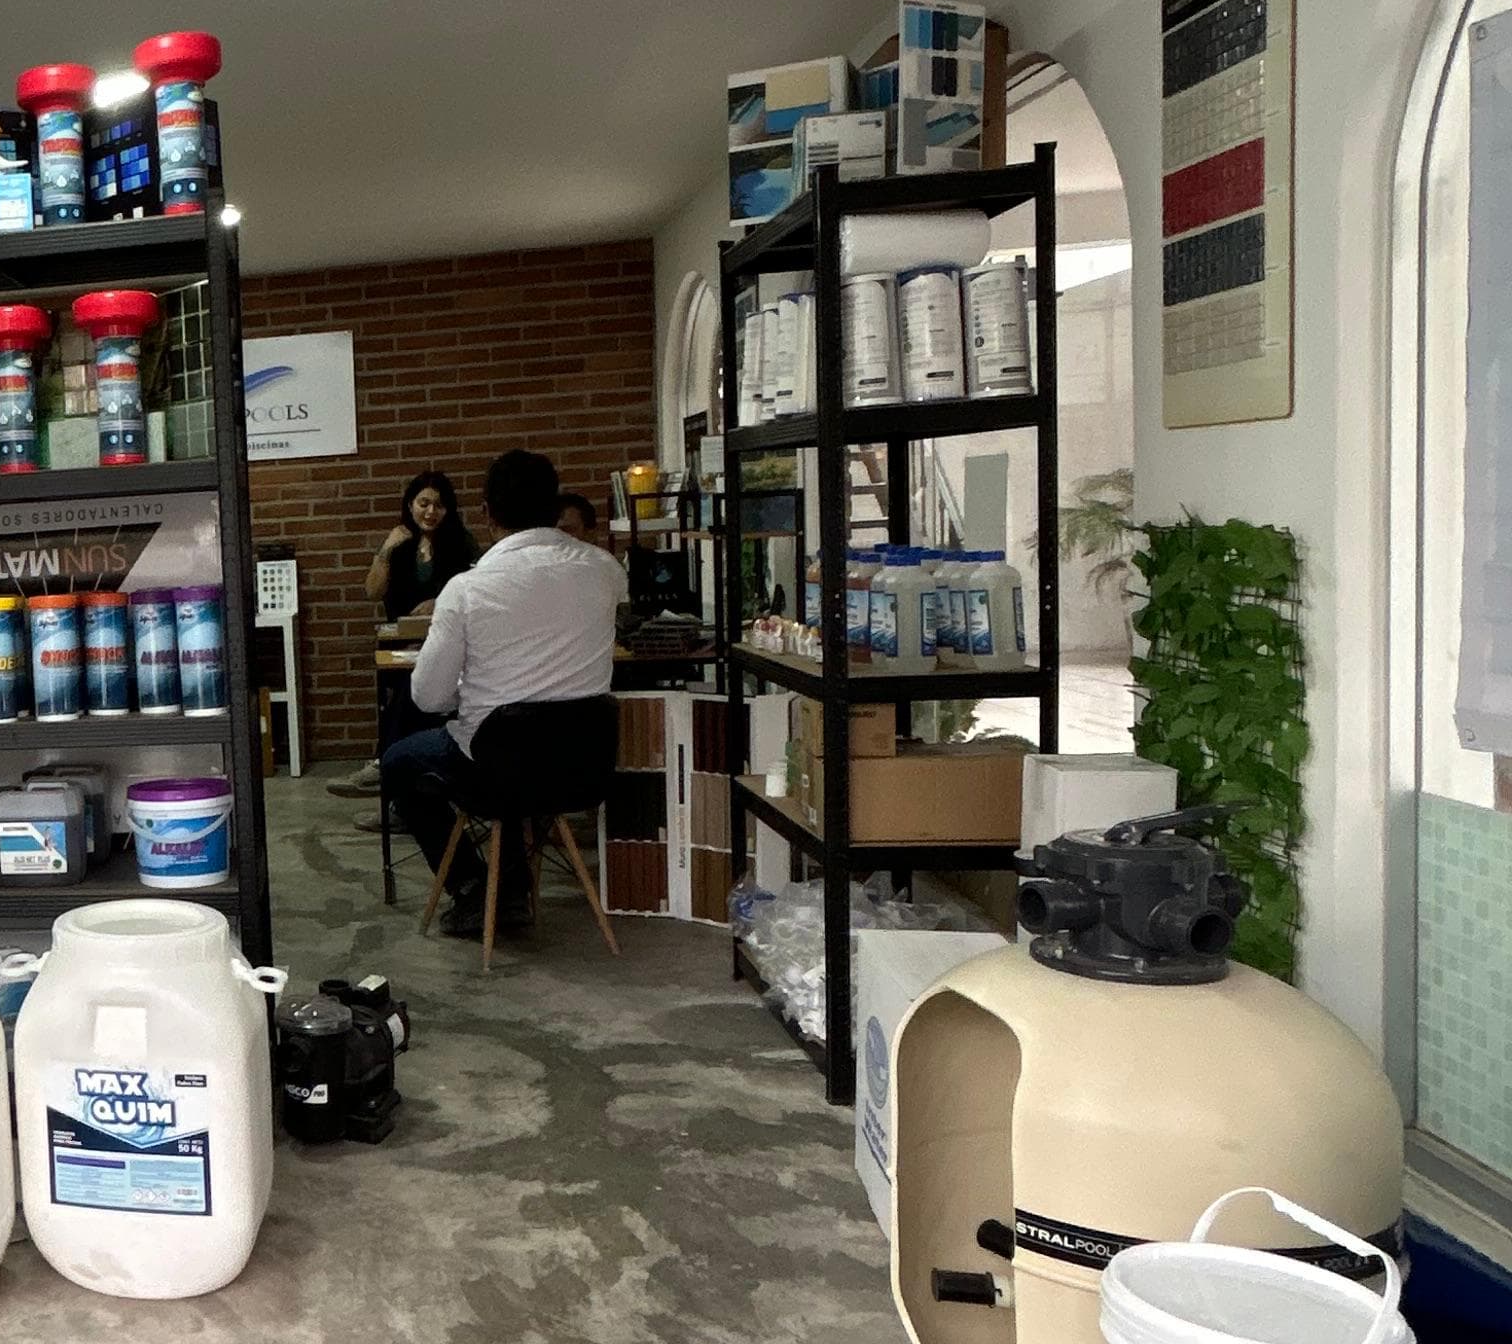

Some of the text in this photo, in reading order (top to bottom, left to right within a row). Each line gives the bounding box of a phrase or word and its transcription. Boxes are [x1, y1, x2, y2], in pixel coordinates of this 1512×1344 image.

[32, 503, 164, 524] CALENTADORES
[76, 1069, 148, 1098] MAX
[91, 1098, 177, 1126] QUIM
[178, 1144, 203, 1155] 50 Kg
